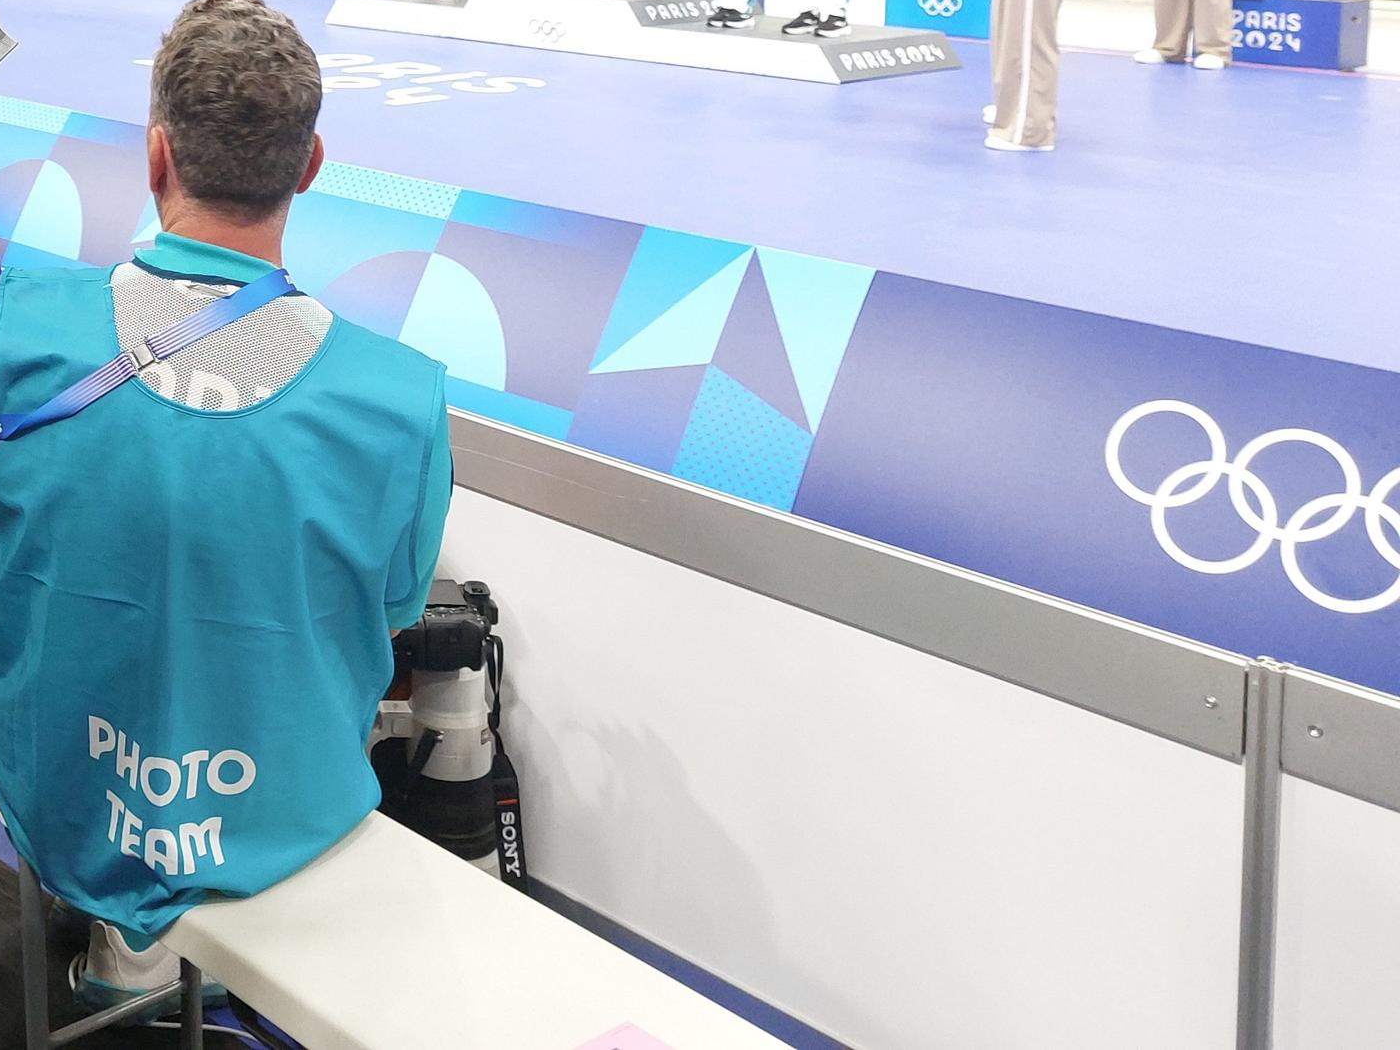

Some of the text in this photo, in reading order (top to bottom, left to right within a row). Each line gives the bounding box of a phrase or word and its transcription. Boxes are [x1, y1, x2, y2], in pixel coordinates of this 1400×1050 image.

[894, 43, 945, 65] 2024
[1232, 29, 1301, 53] 2024
[88, 715, 257, 808] PHOTO
[106, 789, 226, 876] TEAM
[501, 811, 521, 877] SONY
